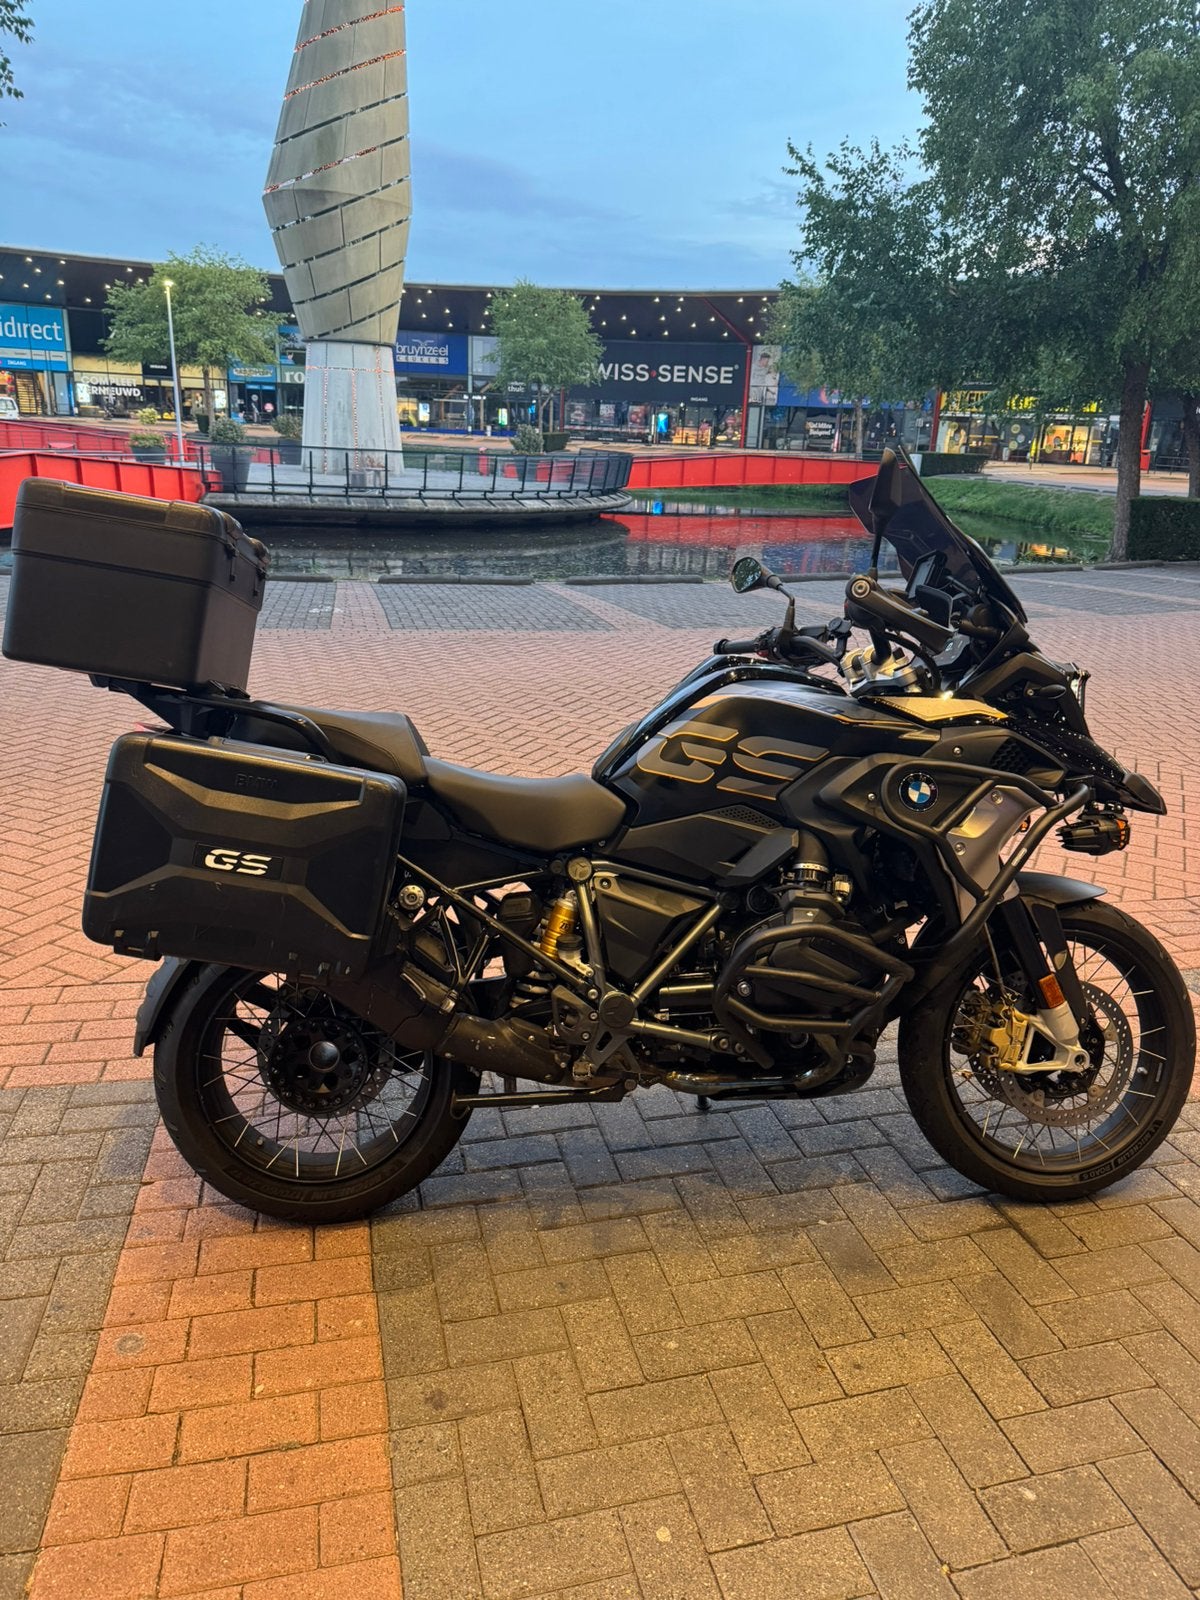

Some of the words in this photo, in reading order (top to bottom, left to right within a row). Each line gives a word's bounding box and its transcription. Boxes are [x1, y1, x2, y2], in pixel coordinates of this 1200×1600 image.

[396, 341, 449, 357] bruynzeel
[637, 720, 830, 801] GS
[205, 849, 272, 875] GS
[1117, 1130, 1152, 1164] MICHELIN
